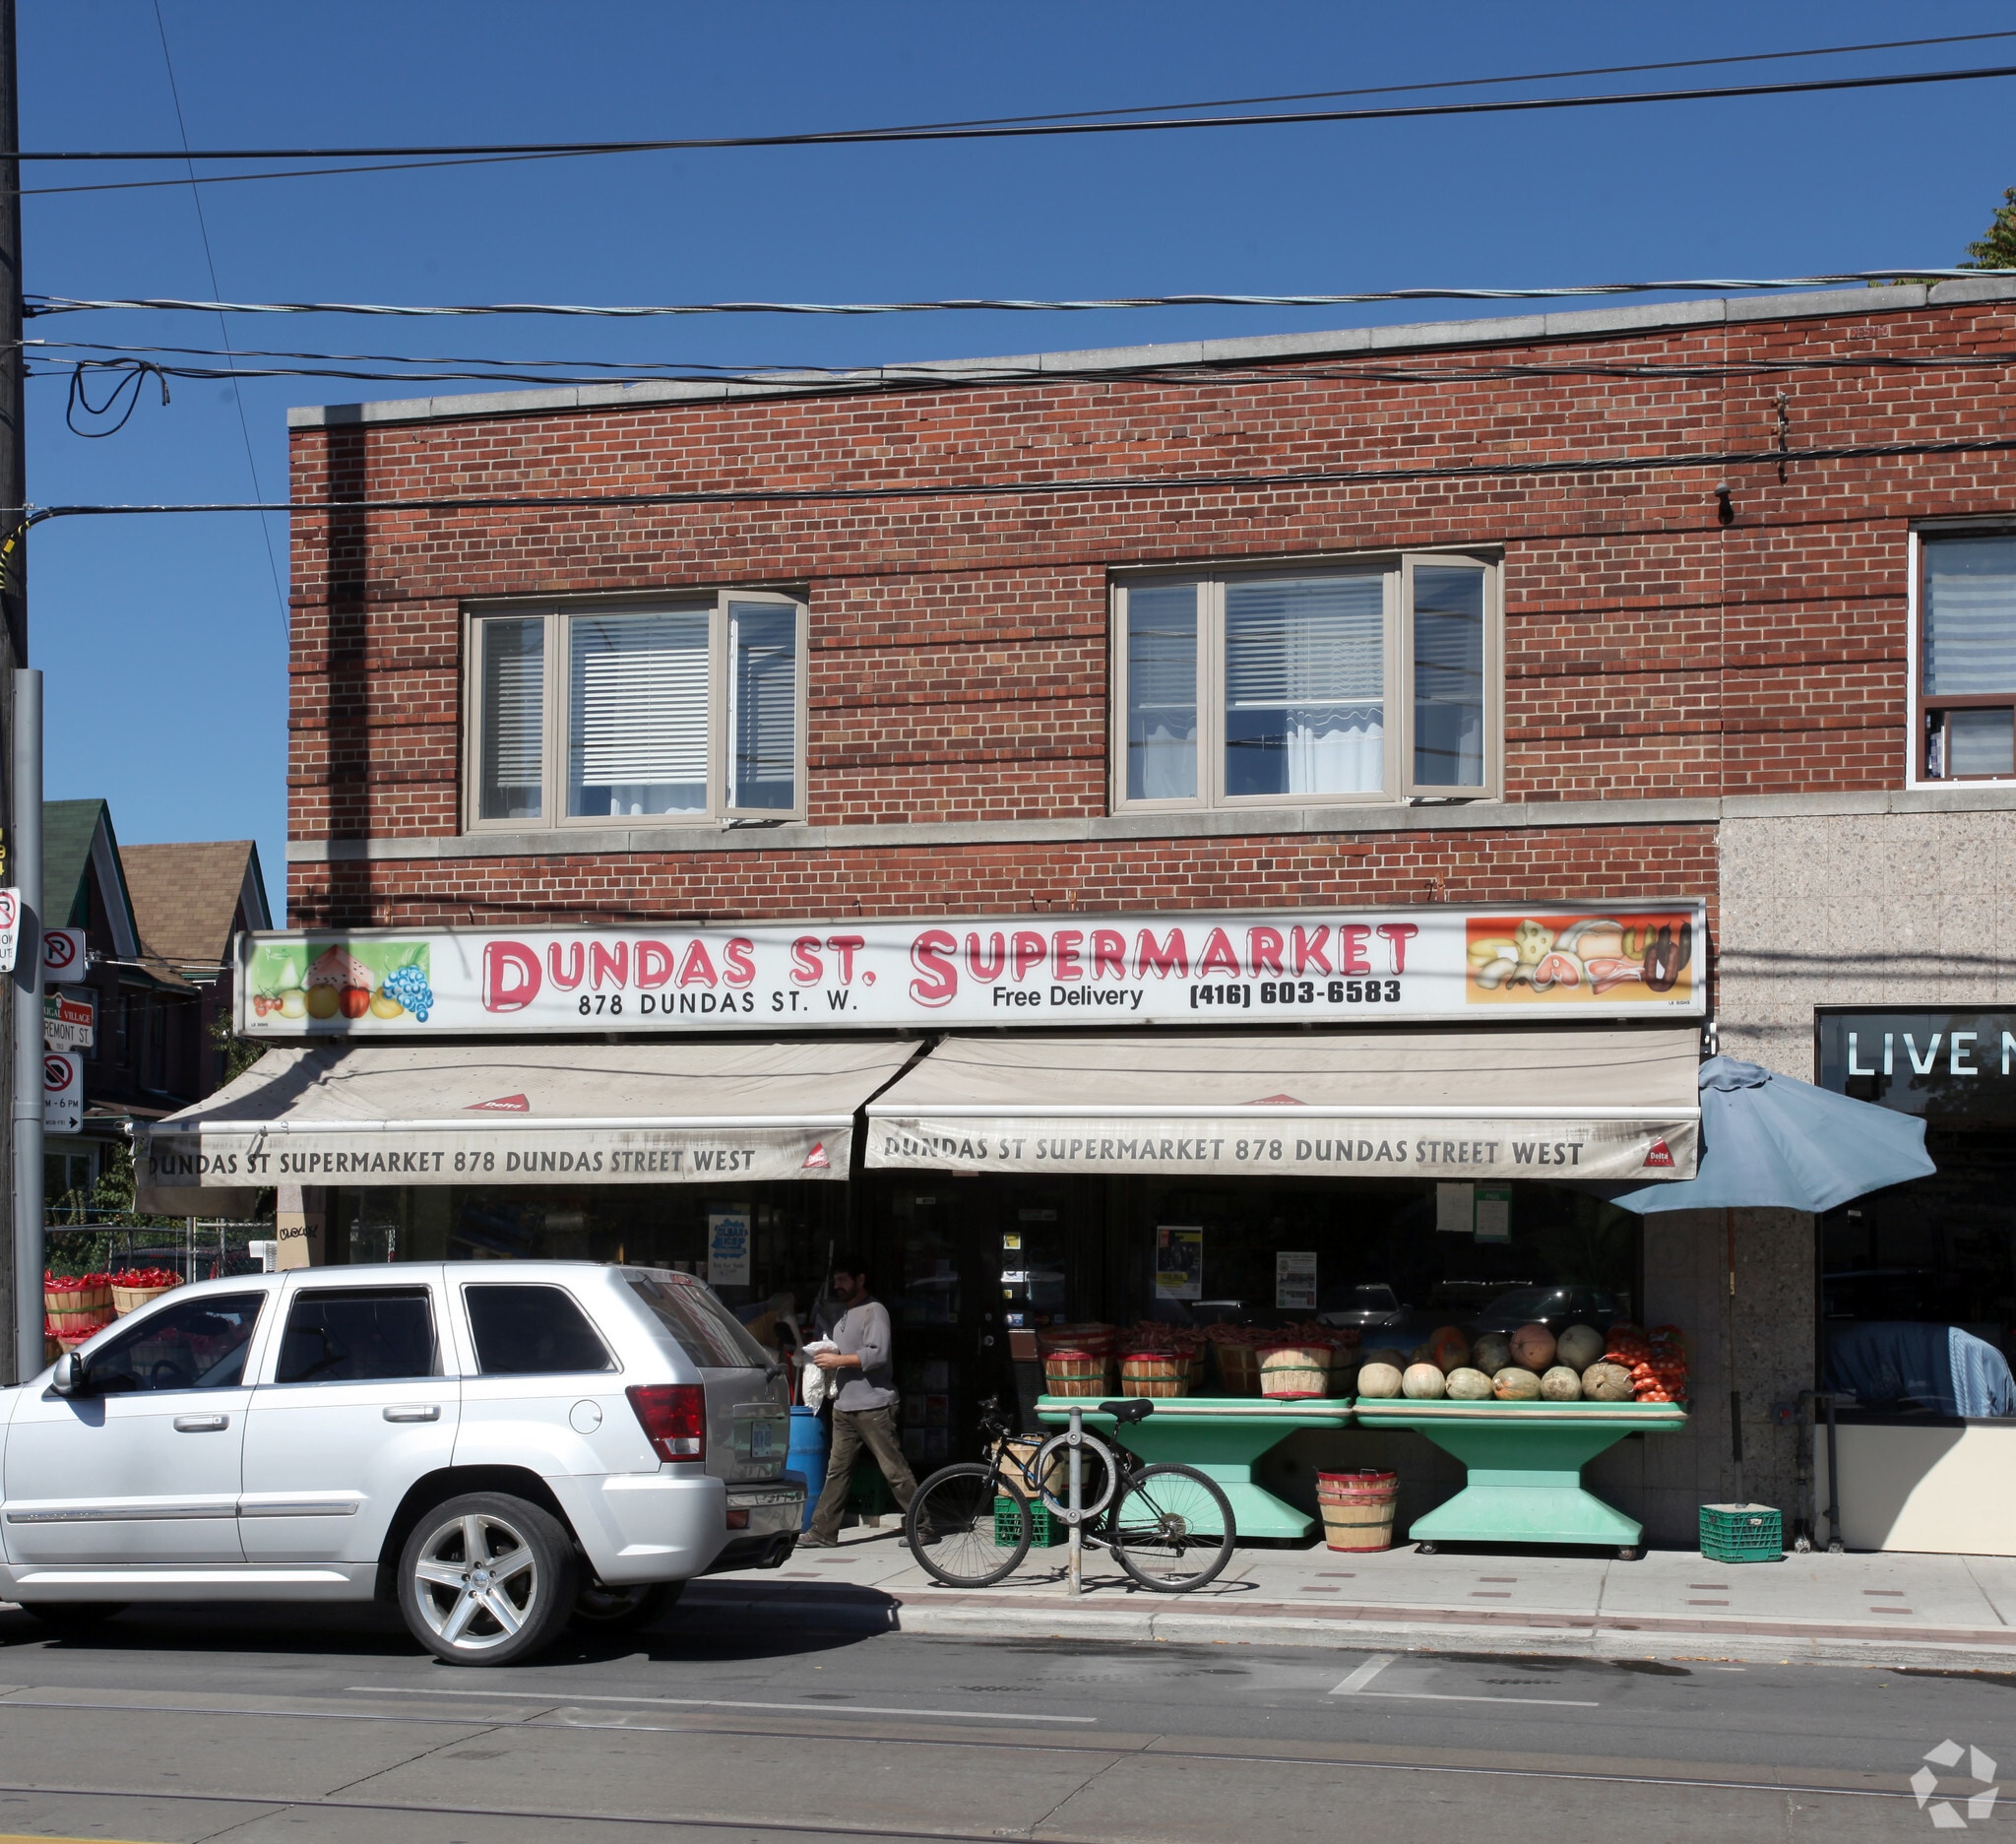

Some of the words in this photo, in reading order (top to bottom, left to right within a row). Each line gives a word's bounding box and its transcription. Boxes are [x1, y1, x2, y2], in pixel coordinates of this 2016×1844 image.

[482, 937, 756, 1013] DUNDAS
[789, 935, 876, 987] ST.
[909, 922, 1419, 1008] SUPERMARKET
[578, 994, 623, 1015] 878
[640, 991, 755, 1015] DUNDAS
[771, 990, 808, 1012] ST.
[827, 989, 857, 1010] W.
[992, 986, 1041, 1006] Free
[1049, 986, 1144, 1010] Delivery
[1190, 985, 1251, 1008] (416)
[1260, 980, 1401, 1004] 603-6583
[64, 1010, 92, 1024] VILLAGE
[1849, 1031, 1979, 1075] LIVE
[150, 1153, 237, 1175] DUNDAS
[247, 1153, 271, 1174] ST
[280, 1151, 445, 1174] SUPERMARKET
[454, 1151, 495, 1172] 878
[505, 1151, 603, 1172] DUNDAS
[610, 1150, 683, 1172] STREET
[692, 1150, 755, 1172] WEST
[884, 1136, 988, 1160] DUNDAS
[998, 1138, 1026, 1160] ST
[1036, 1138, 1225, 1161] SUPERMARKET
[1234, 1139, 1284, 1161] 878
[1294, 1138, 1408, 1162] DUNDAS
[1416, 1139, 1498, 1164] STREET
[1512, 1141, 1584, 1166] WEST
